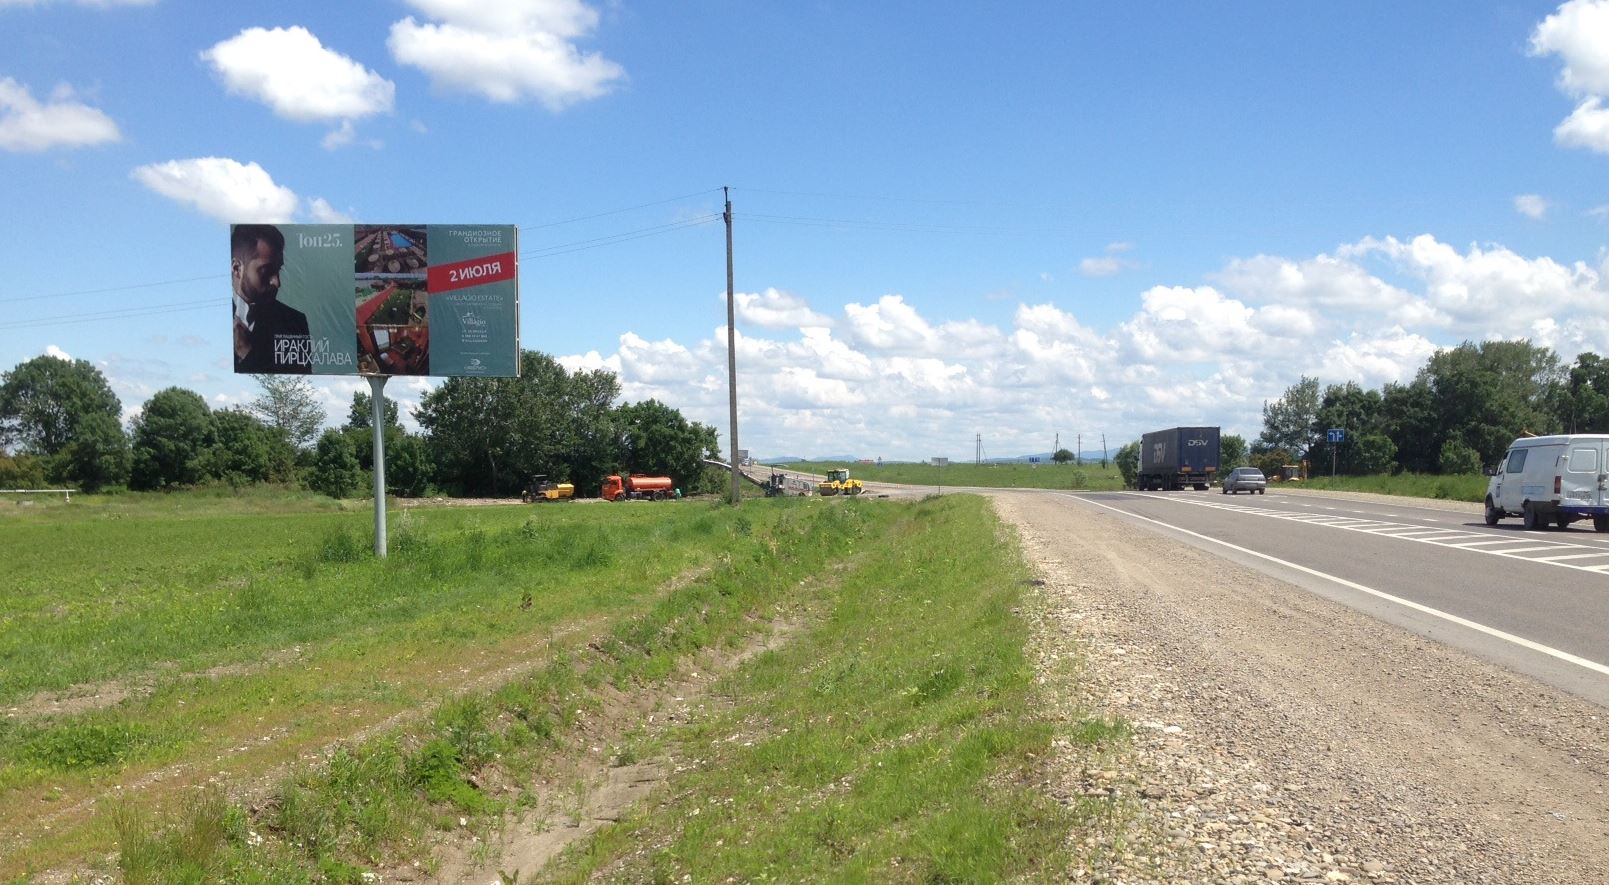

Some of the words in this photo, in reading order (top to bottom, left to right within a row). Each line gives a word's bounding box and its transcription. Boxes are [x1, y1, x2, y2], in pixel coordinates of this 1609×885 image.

[449, 270, 458, 282] 2
[459, 261, 502, 280] ИЮЛЯ
[274, 337, 330, 352] ИРАКЛИЙ
[274, 352, 353, 367] ПИРЦХАЛАВА
[1187, 439, 1209, 447] DSV
